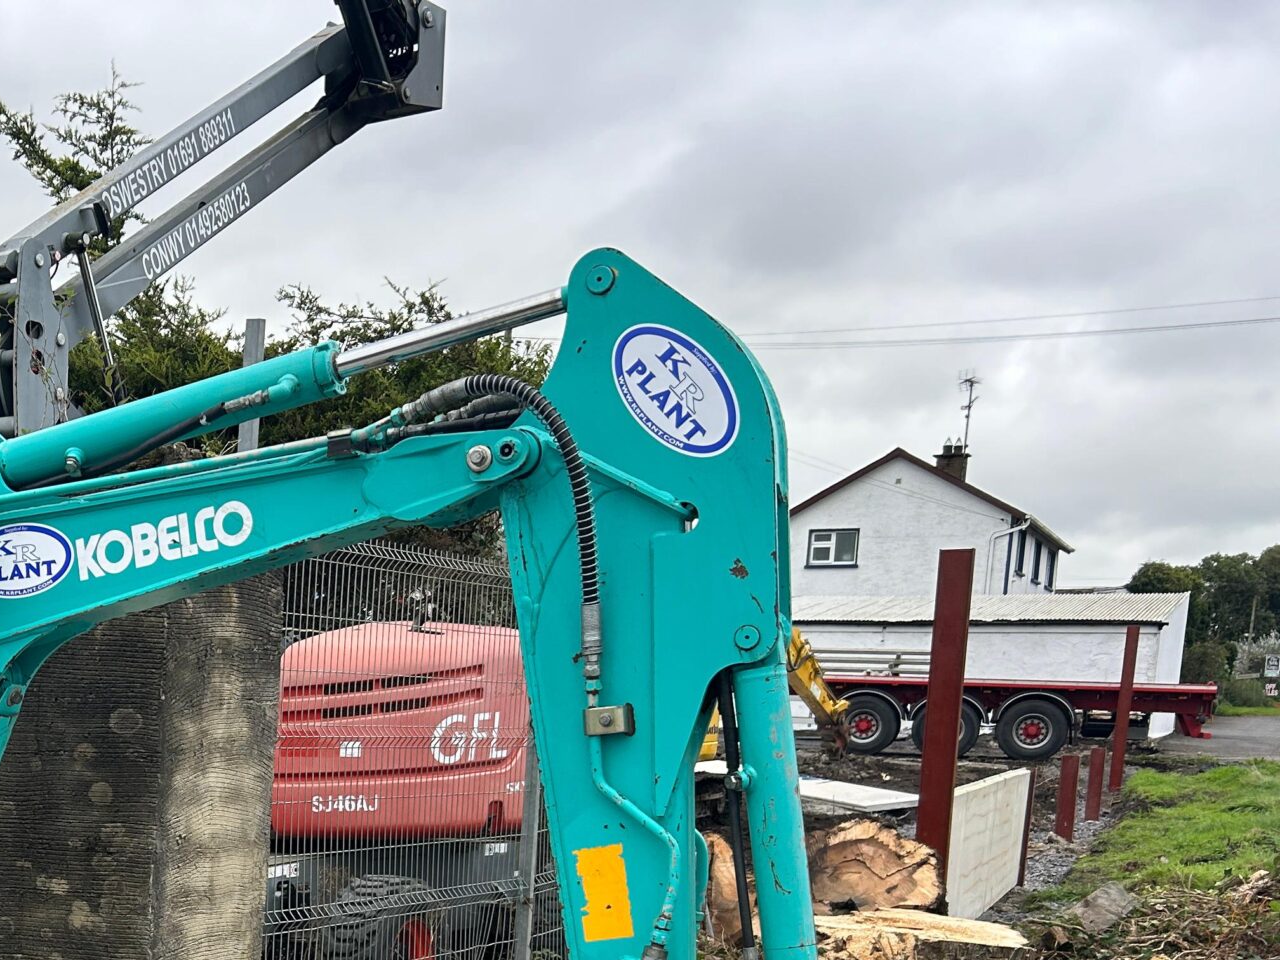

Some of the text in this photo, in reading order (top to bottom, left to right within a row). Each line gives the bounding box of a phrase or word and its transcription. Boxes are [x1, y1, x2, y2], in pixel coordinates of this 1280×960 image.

[102, 107, 236, 217] OSWESTRY 01691 889311
[142, 182, 251, 280] CONWY 01492580123
[625, 358, 707, 441] PLANT
[75, 500, 253, 581] KOBELCO
[430, 711, 508, 765] GFL
[312, 794, 379, 813] SJ46AJ
[506, 781, 525, 794] SK
